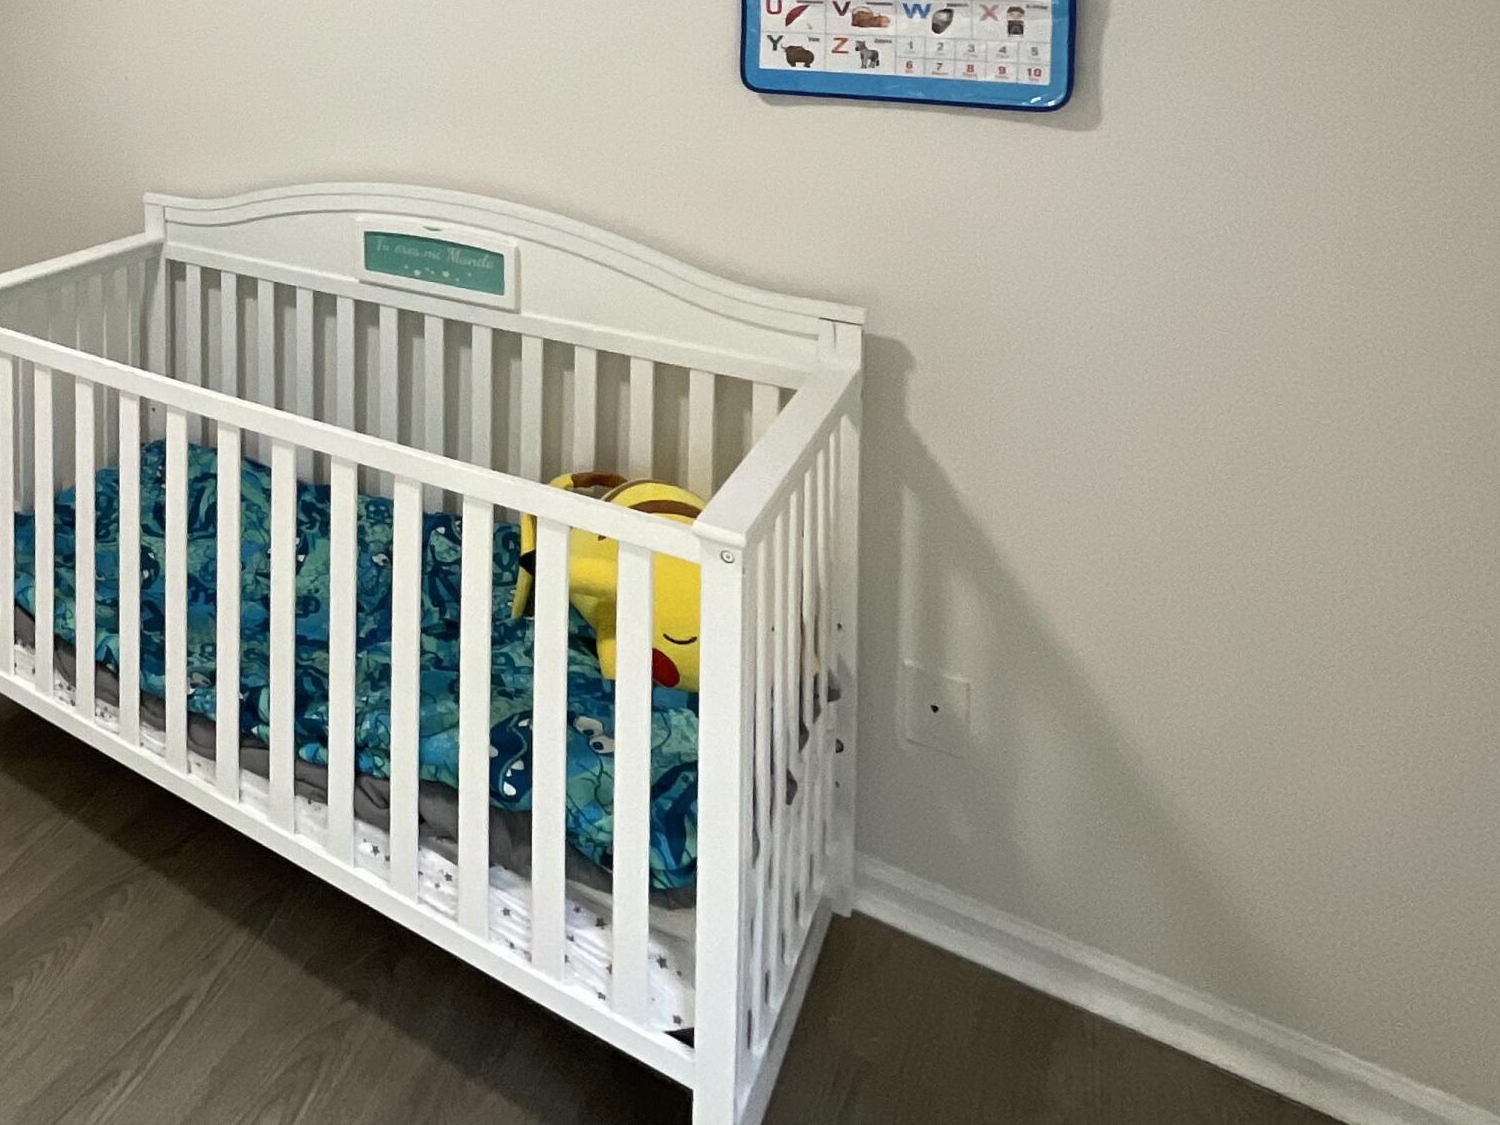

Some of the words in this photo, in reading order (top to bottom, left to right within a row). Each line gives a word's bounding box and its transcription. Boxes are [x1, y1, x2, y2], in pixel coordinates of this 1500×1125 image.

[766, 0, 782, 15] U
[832, 1, 851, 16] V
[902, 3, 932, 19] W
[979, 4, 999, 21] X
[766, 35, 784, 51] Y
[831, 37, 849, 54] Z
